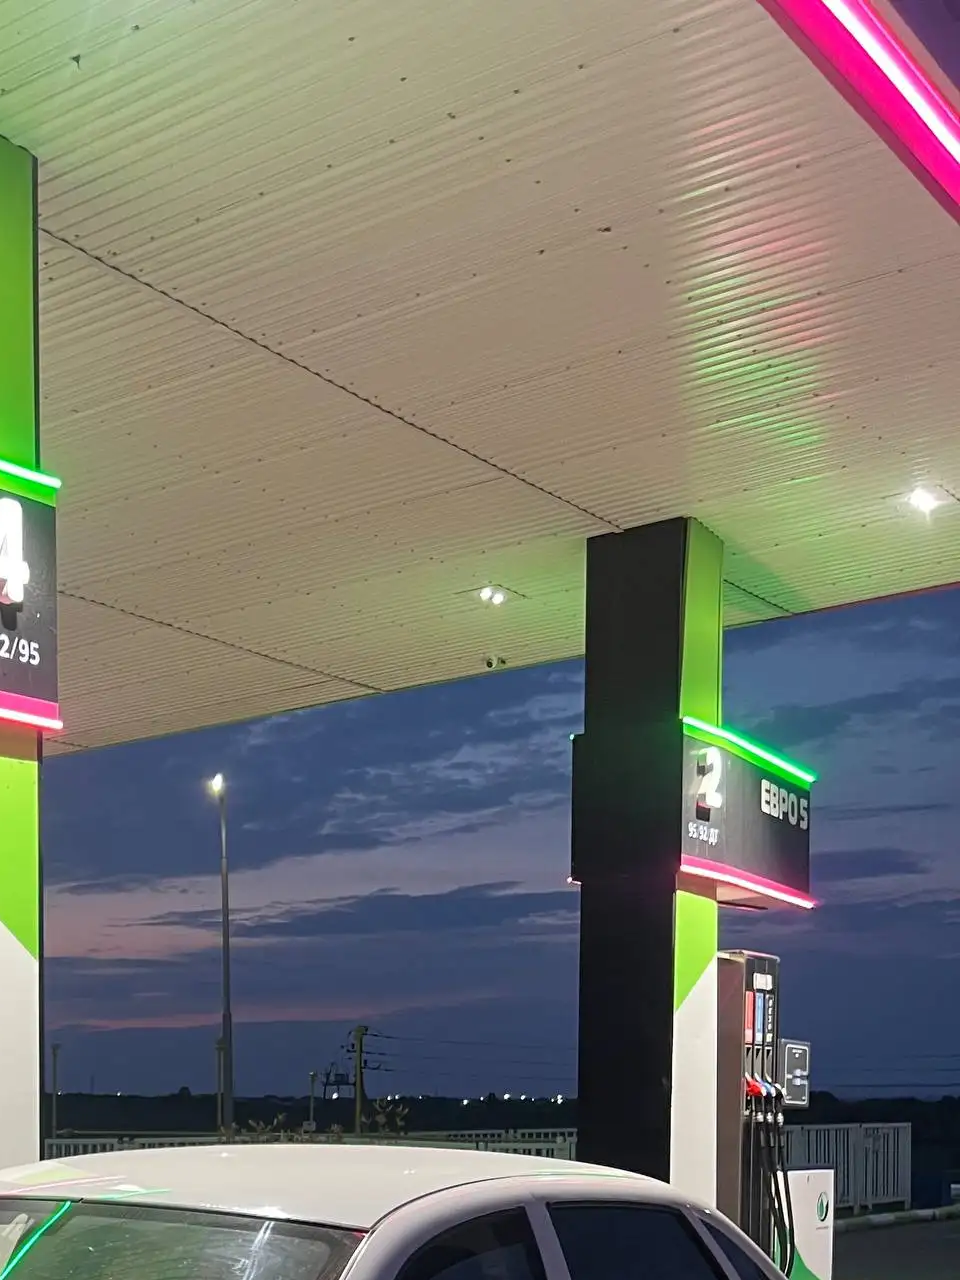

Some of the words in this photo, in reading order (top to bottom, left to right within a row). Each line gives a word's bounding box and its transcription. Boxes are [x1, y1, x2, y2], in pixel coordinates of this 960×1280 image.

[697, 746, 723, 809] 2
[761, 778, 798, 826] ЕВРО
[799, 797, 809, 831] 5
